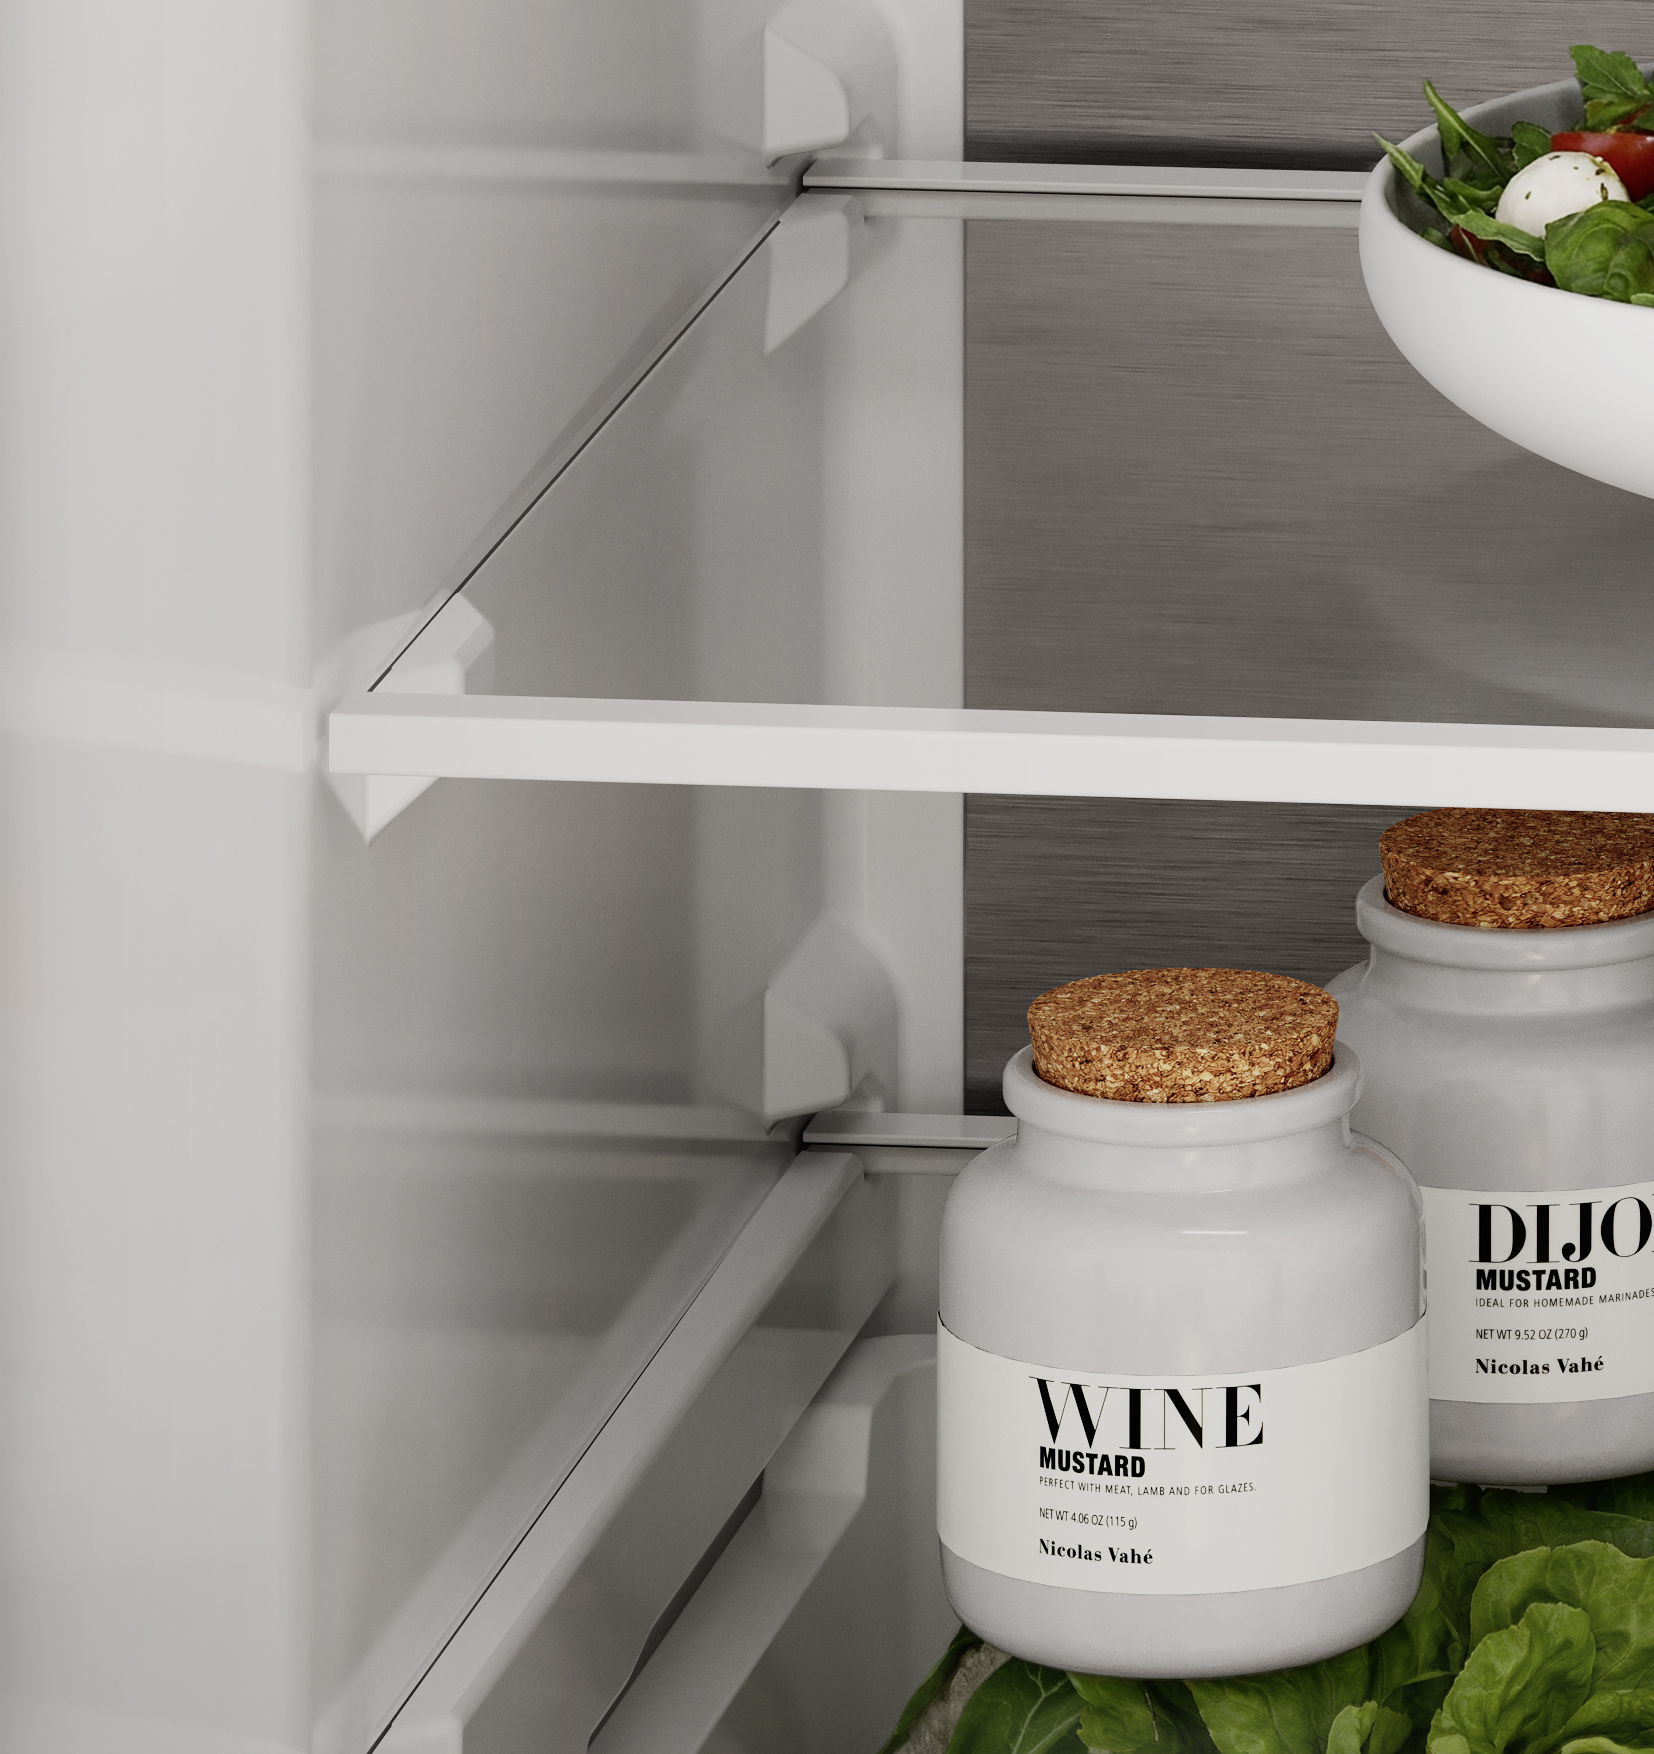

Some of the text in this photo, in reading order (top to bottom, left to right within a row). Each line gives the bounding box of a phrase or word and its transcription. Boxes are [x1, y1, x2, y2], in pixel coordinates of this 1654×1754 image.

[1476, 1267, 1596, 1291] MUSTARD
[1476, 1298, 1504, 1307] IDEAL
[1509, 1299, 1529, 1308] FOR
[1534, 1296, 1593, 1307] HOMEMADE
[1599, 1288, 1654, 1303] MARINADES
[1476, 1329, 1494, 1339] NET
[1496, 1329, 1512, 1339] WT
[1515, 1329, 1535, 1340] 9.52
[1538, 1329, 1552, 1340] OZ
[1476, 1356, 1604, 1374] Nicolas Vahé
[1029, 1376, 1263, 1450] WINE
[1040, 1446, 1145, 1479] MUSTARD
[1040, 1476, 1074, 1489] PERFECT
[1078, 1482, 1101, 1492] WITH
[1138, 1486, 1165, 1496] LAMB
[1169, 1487, 1189, 1496] AND
[1195, 1485, 1213, 1495] FOR
[1040, 1507, 1053, 1519] NET
[1056, 1510, 1068, 1521] WT
[1091, 1514, 1104, 1526] OZ
[1040, 1538, 1153, 1564] Nicolas Vahé
